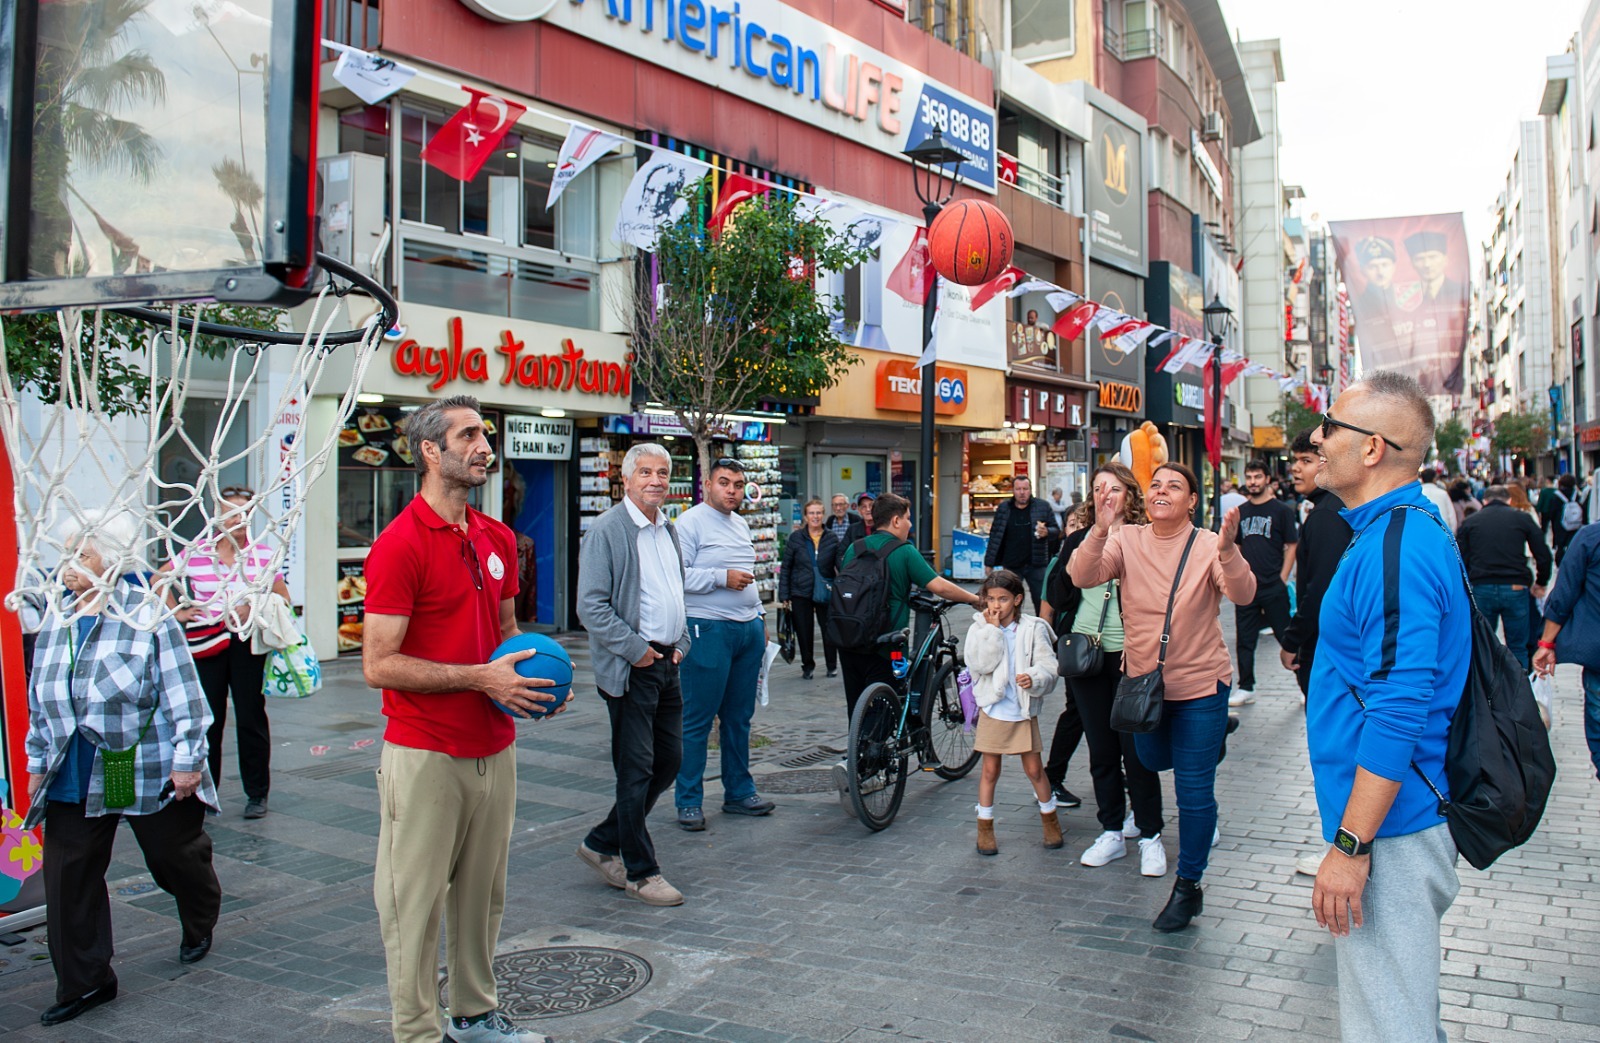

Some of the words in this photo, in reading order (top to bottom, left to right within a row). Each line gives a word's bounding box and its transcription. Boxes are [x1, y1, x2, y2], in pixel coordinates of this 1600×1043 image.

[921, 94, 948, 133] 368
[950, 109, 970, 142] 88
[971, 118, 990, 151] 88
[1104, 132, 1128, 196] M
[971, 257, 981, 265] 5
[394, 316, 489, 392] ayla
[494, 329, 634, 398] tantuni
[888, 375, 964, 399] TEKSA
[1099, 380, 1142, 412] MEZZO
[508, 418, 532, 434] NİGET
[512, 437, 521, 456] İŞ
[523, 441, 544, 453] HANI
[547, 442, 565, 455] No:7
